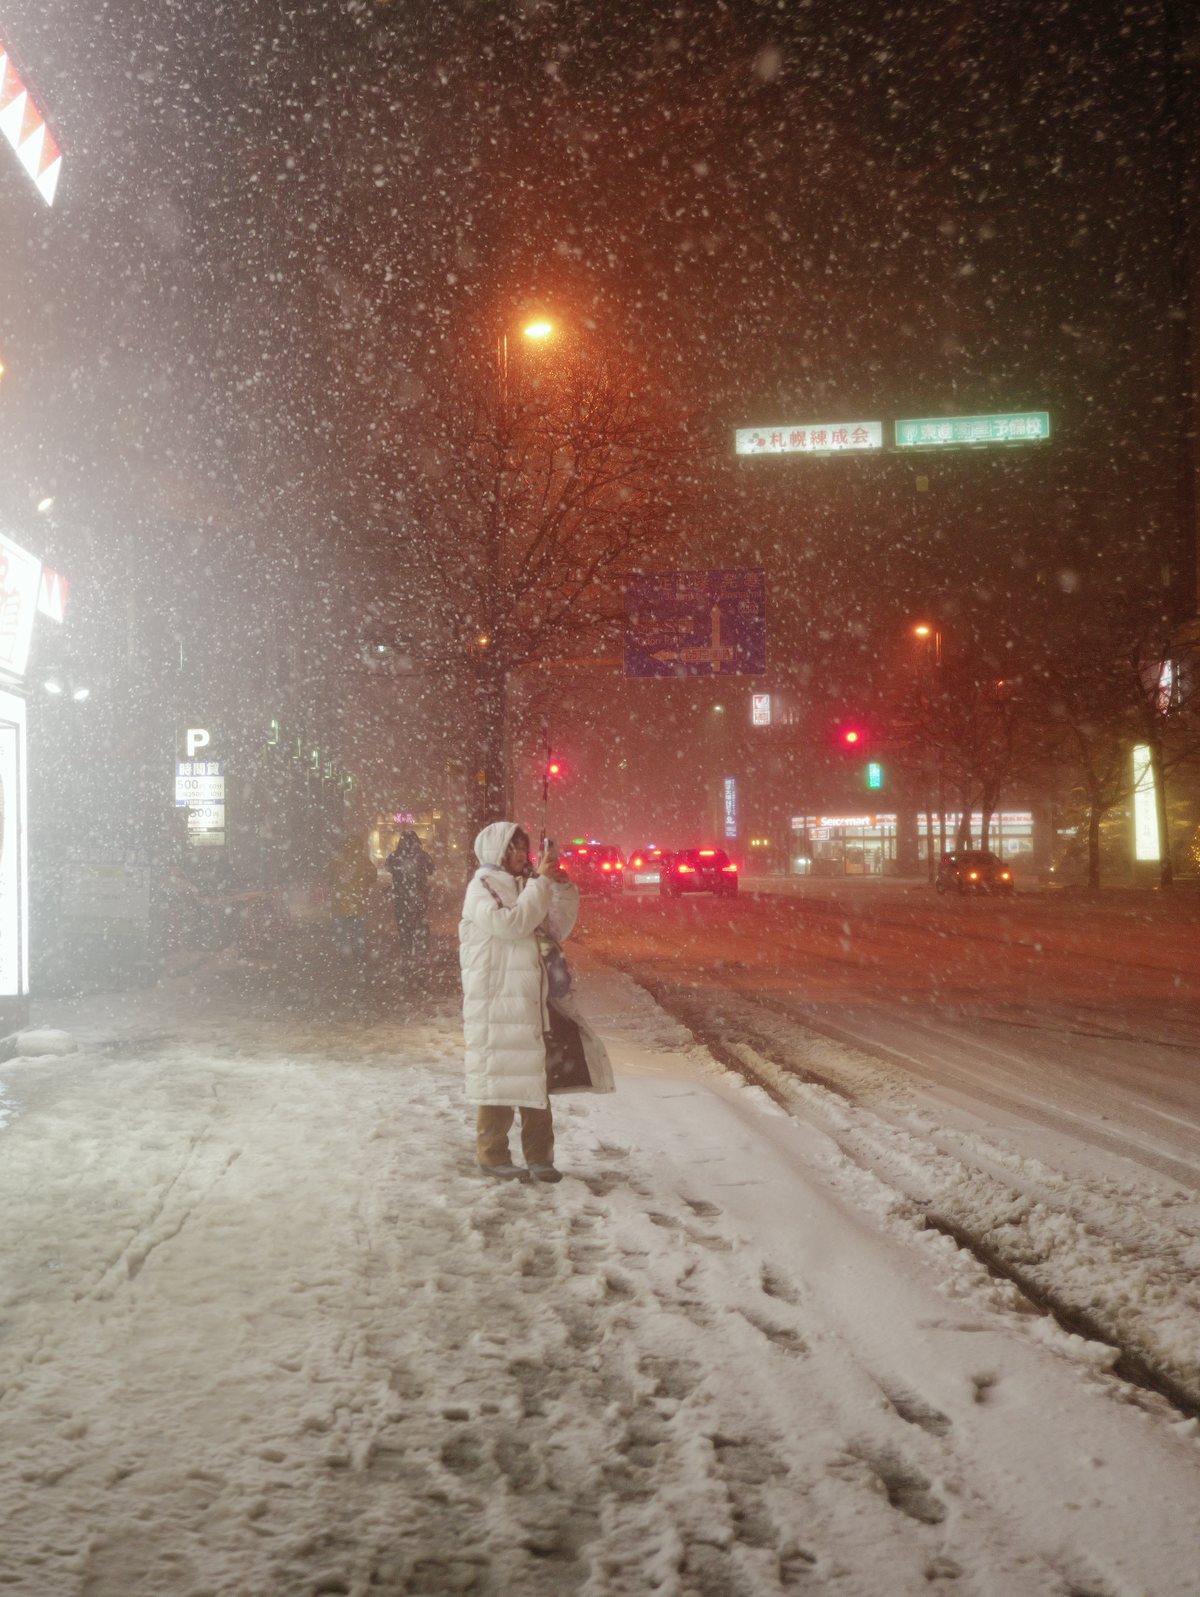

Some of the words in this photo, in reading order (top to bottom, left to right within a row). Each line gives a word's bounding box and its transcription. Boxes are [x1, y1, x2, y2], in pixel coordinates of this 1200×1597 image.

[770, 427, 869, 448] 札幌練成会
[187, 728, 210, 756] P
[179, 762, 219, 775] 時間貸
